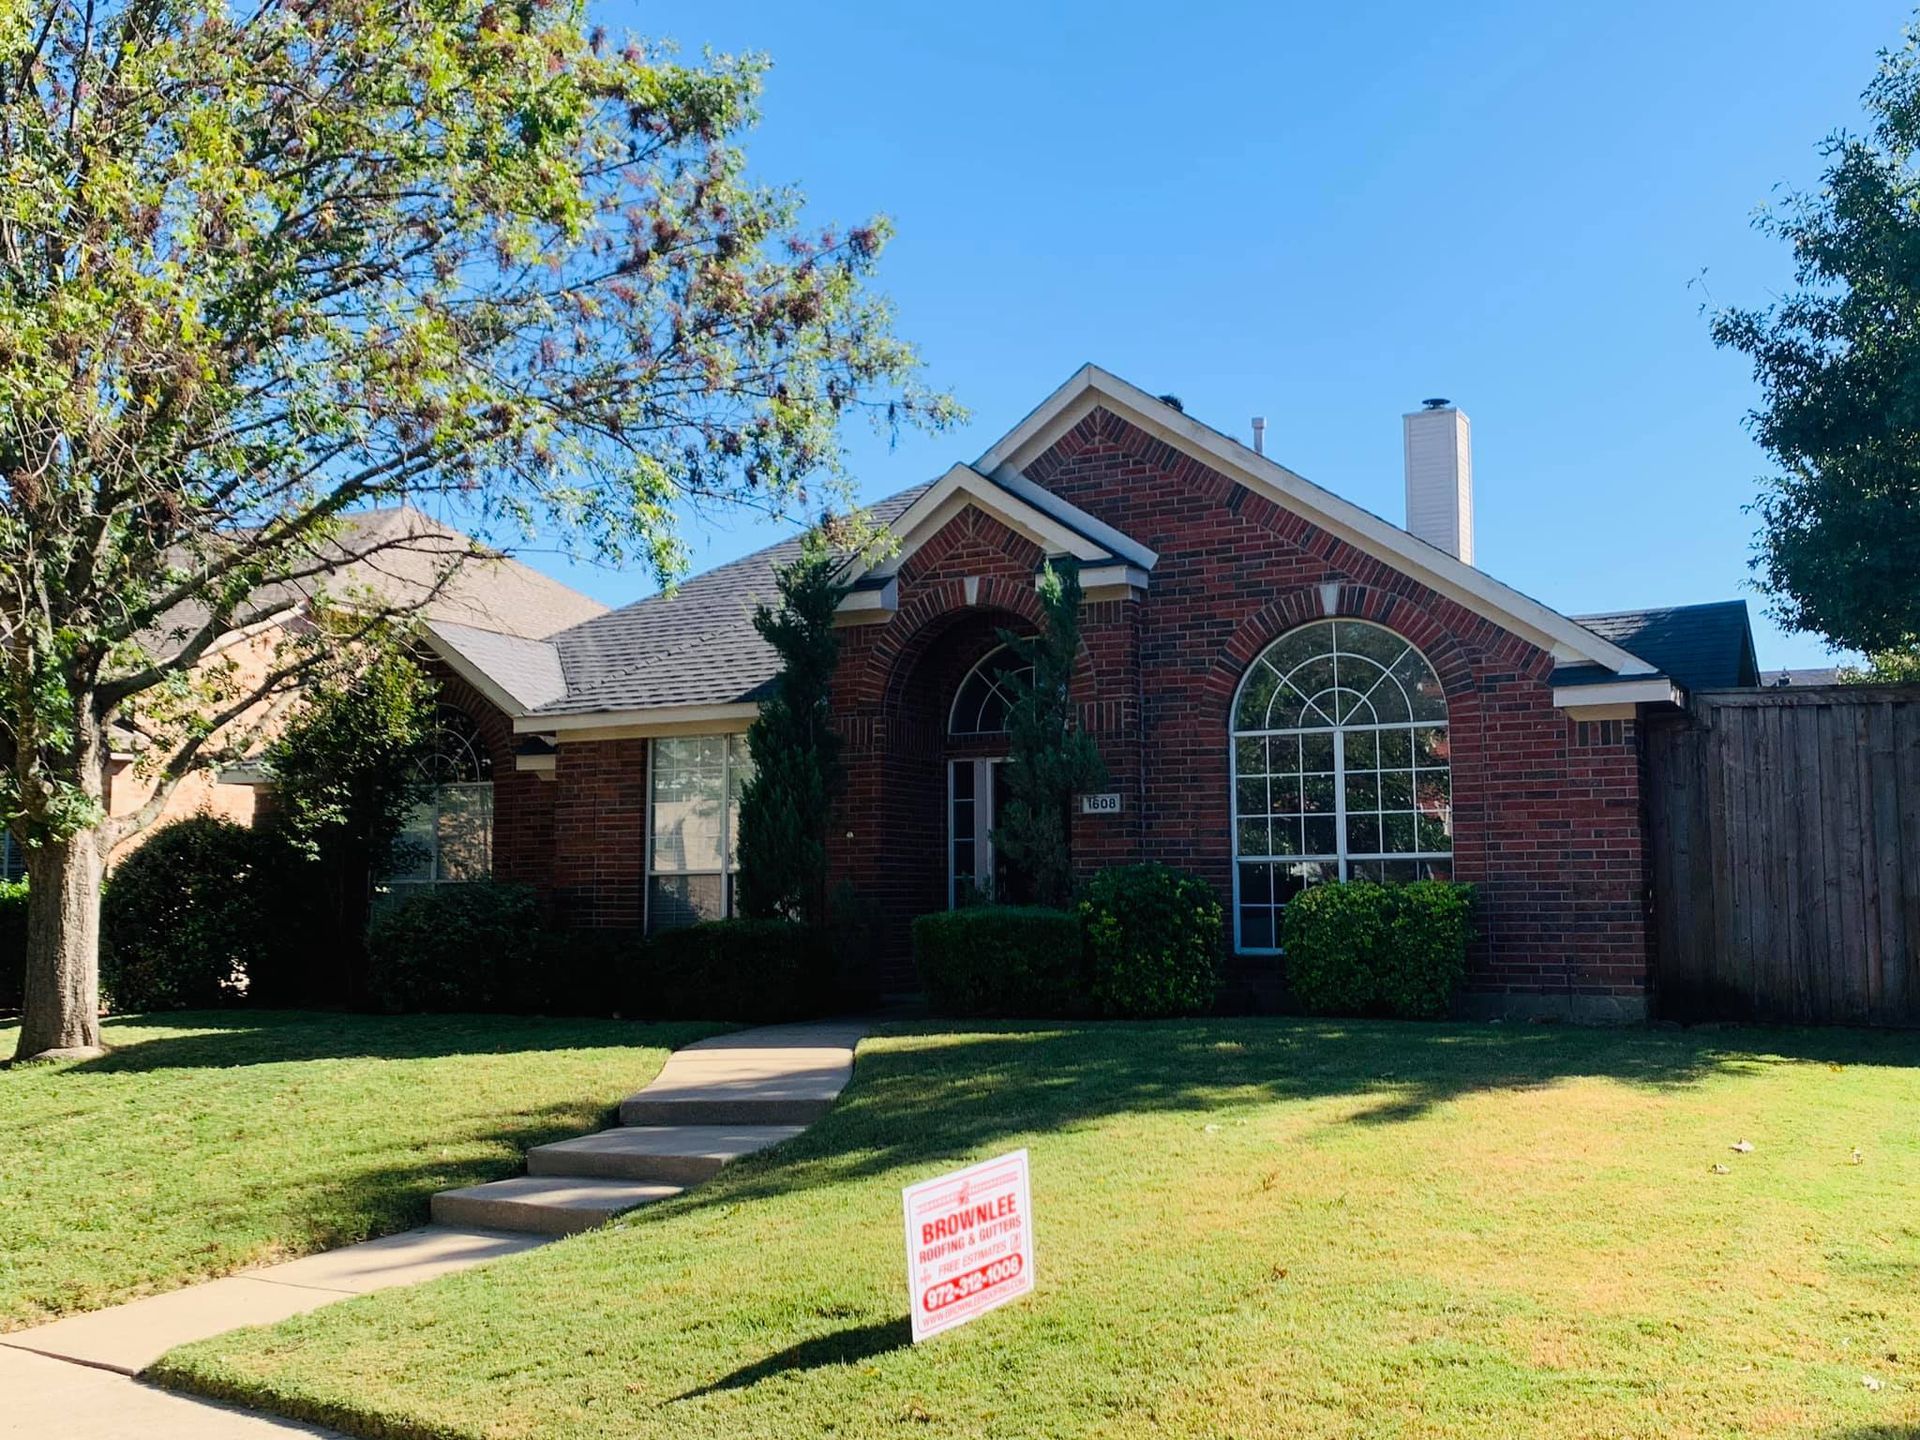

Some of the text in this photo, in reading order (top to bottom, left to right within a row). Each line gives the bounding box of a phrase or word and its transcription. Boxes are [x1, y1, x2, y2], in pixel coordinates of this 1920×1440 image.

[1088, 797, 1116, 810] 1608
[919, 1214, 1022, 1265] ROOFING & GUTTERS
[921, 1192, 1017, 1246] BROWNLEE
[927, 1256, 1019, 1309] 972-312-1008
[938, 1239, 1007, 1277] FREE ESTIMATES
